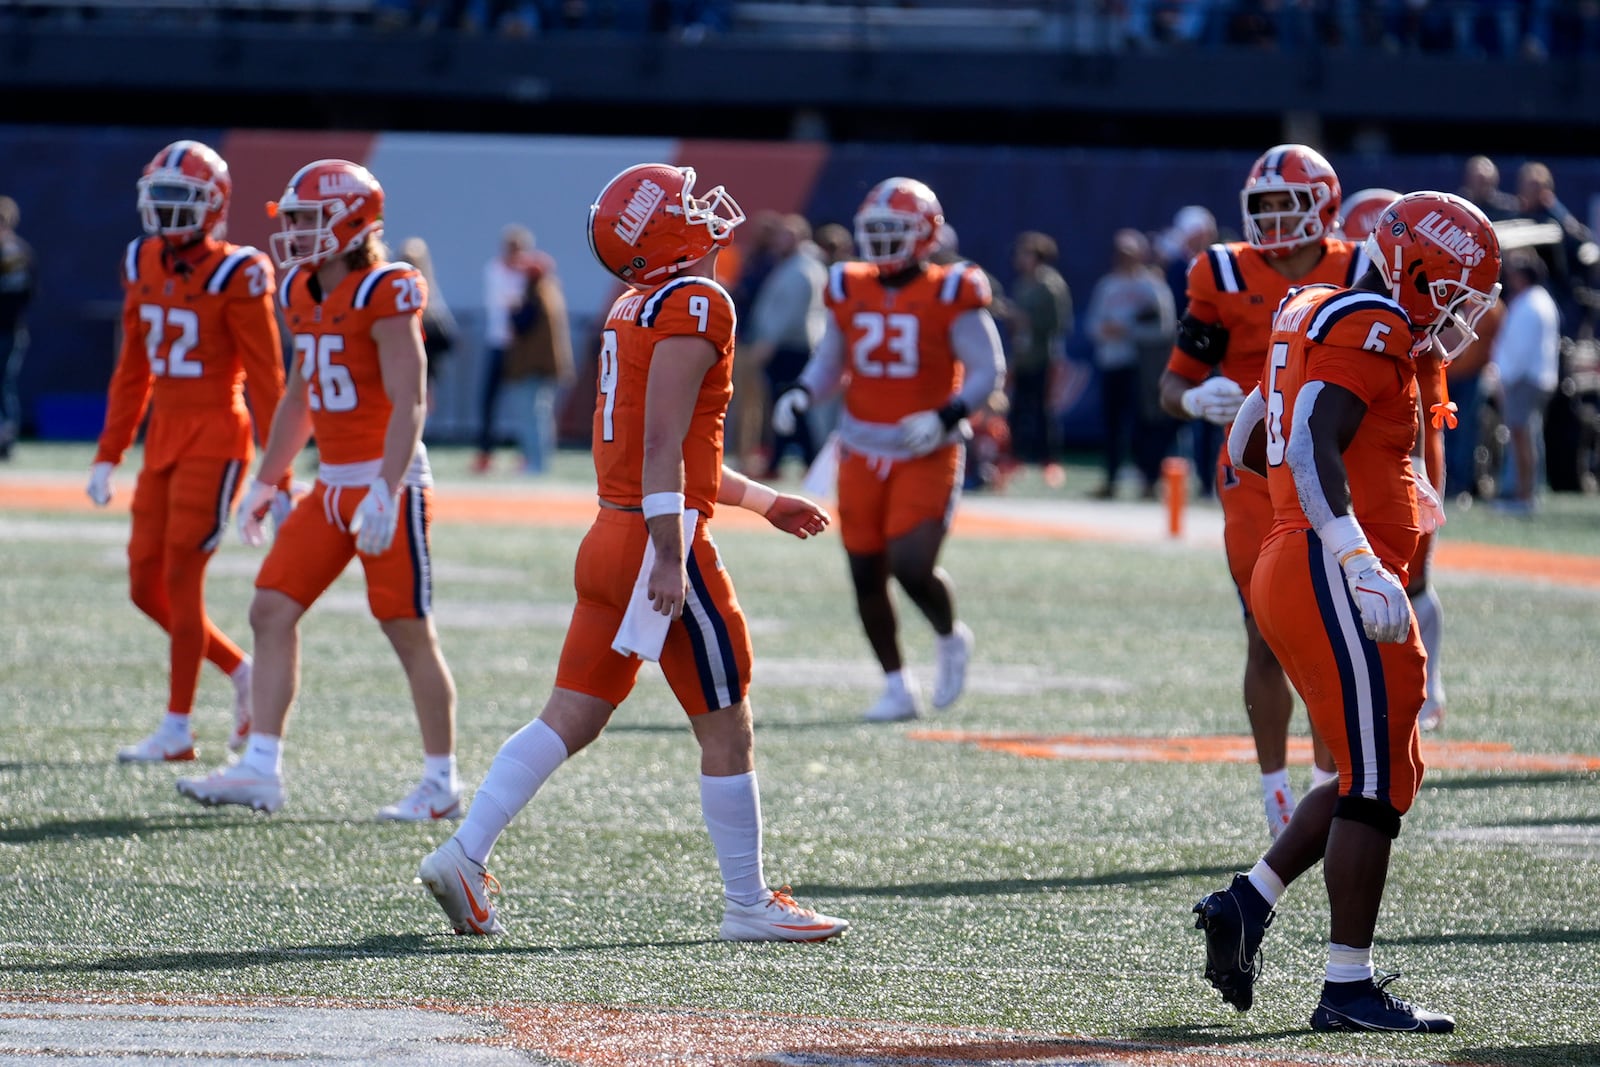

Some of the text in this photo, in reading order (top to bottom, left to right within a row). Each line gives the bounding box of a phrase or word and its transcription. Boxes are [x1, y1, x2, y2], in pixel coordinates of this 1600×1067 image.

[614, 179, 664, 247] ILLINOIS
[139, 303, 203, 378] 22
[688, 295, 710, 333] 9
[852, 311, 919, 379] 23
[1362, 321, 1392, 353] 6
[294, 333, 359, 412] 26
[600, 329, 619, 443] 9
[1266, 342, 1289, 467] 6
